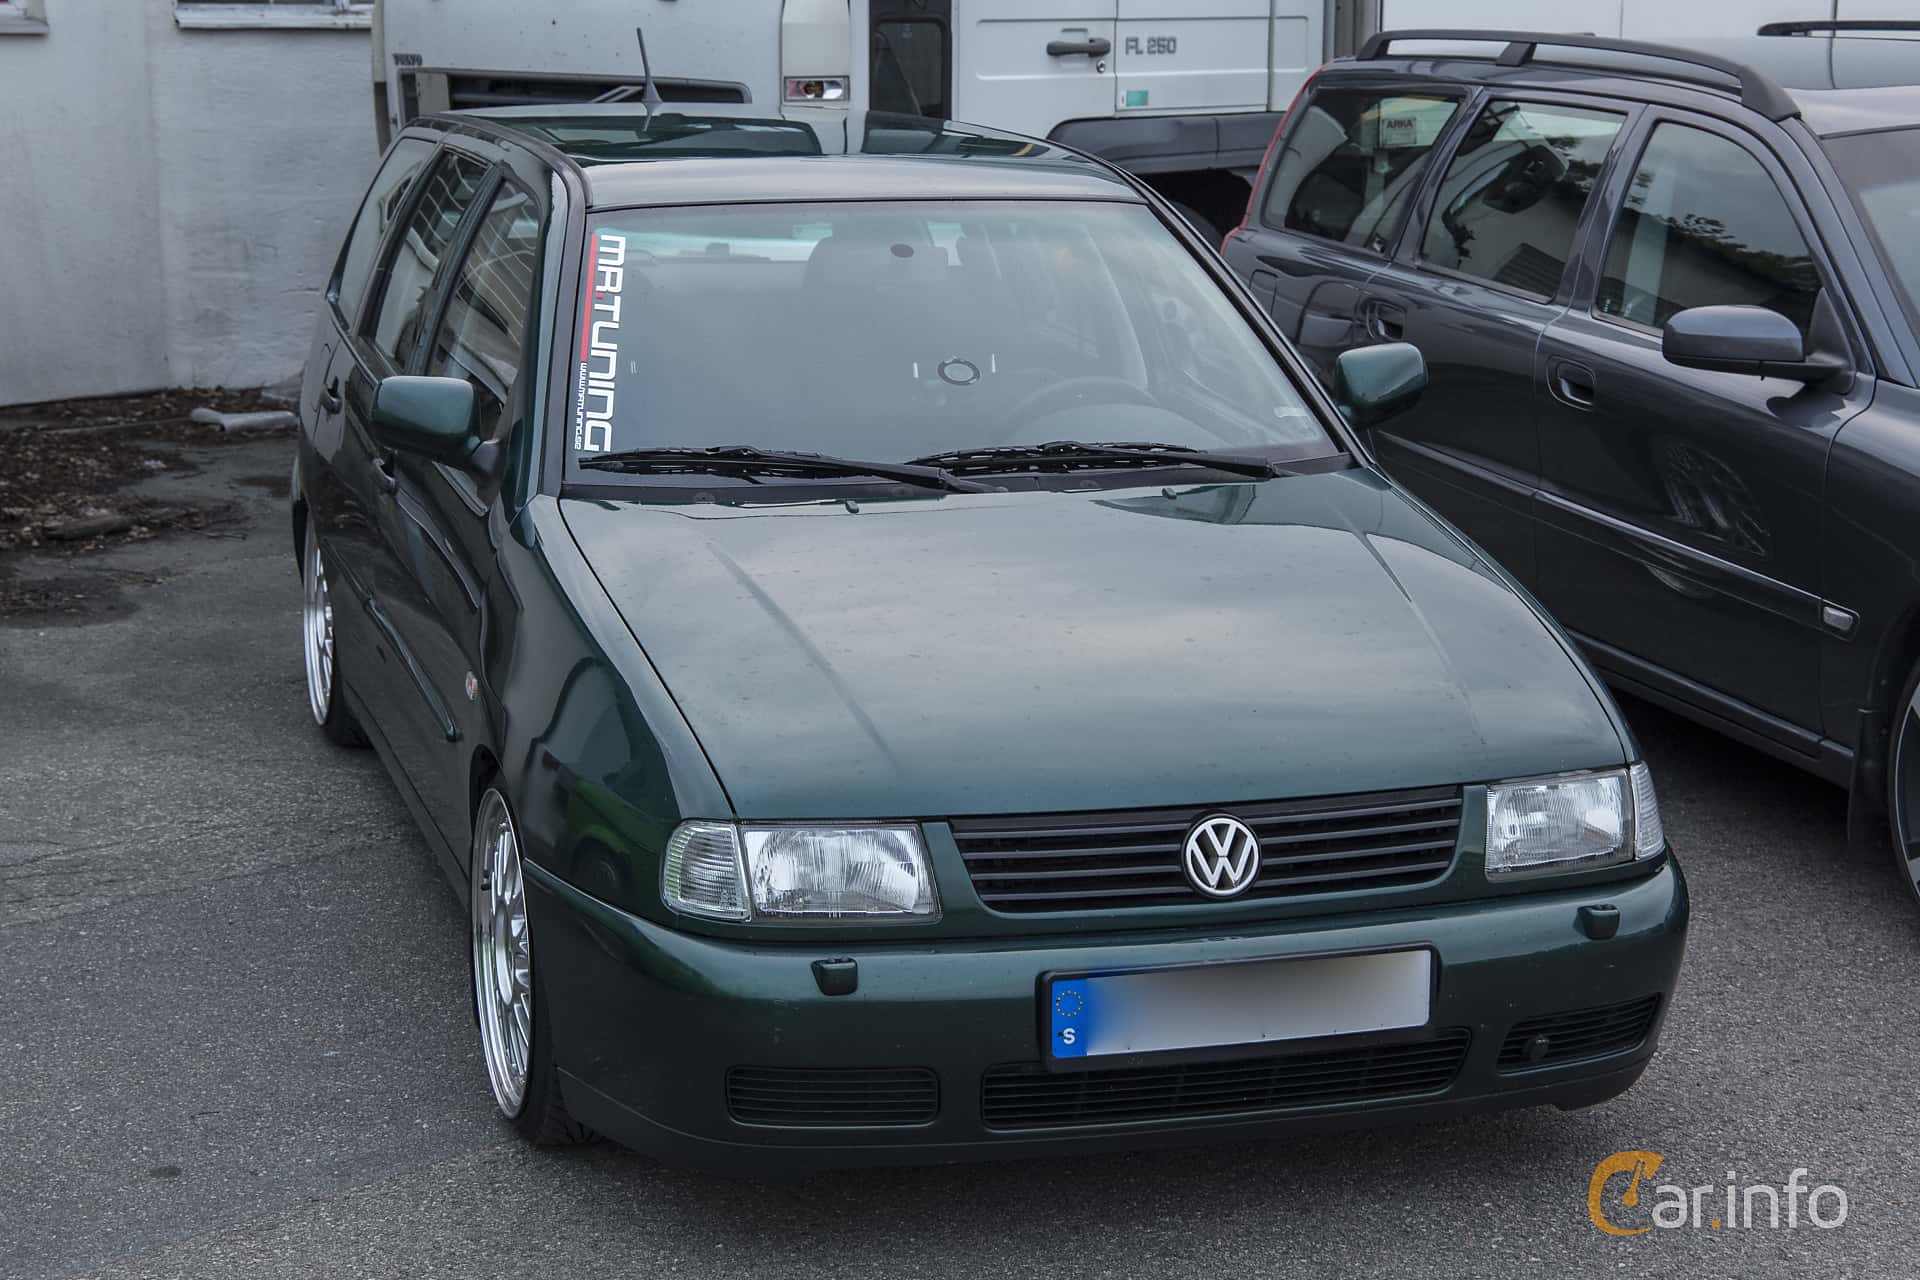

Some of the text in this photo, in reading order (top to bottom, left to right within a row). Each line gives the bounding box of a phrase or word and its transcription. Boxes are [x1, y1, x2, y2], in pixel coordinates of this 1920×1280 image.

[1125, 36, 1177, 54] FL 250
[1063, 1027, 1076, 1045] S
